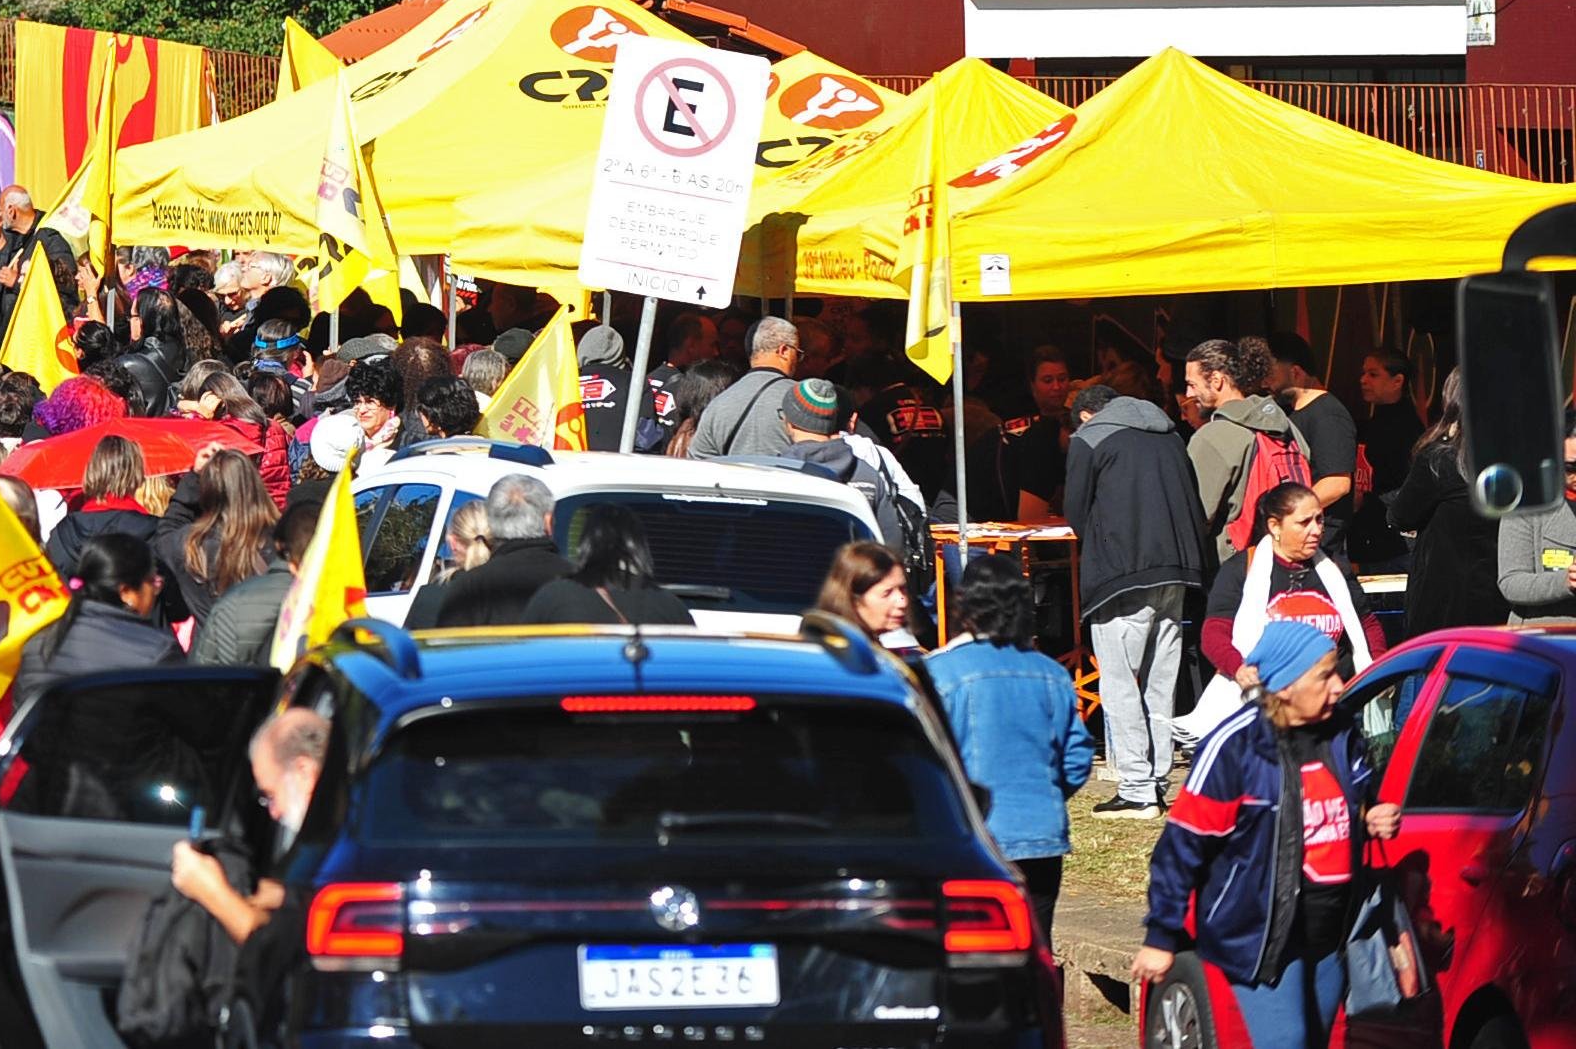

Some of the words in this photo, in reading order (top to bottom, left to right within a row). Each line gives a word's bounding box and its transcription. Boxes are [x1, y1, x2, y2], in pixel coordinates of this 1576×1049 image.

[151, 198, 182, 229] Acesse
[184, 206, 189, 230] o
[627, 200, 707, 226] EMBARQUE
[609, 216, 720, 246] DESEMBARQUE
[820, 251, 855, 280] Núcleo
